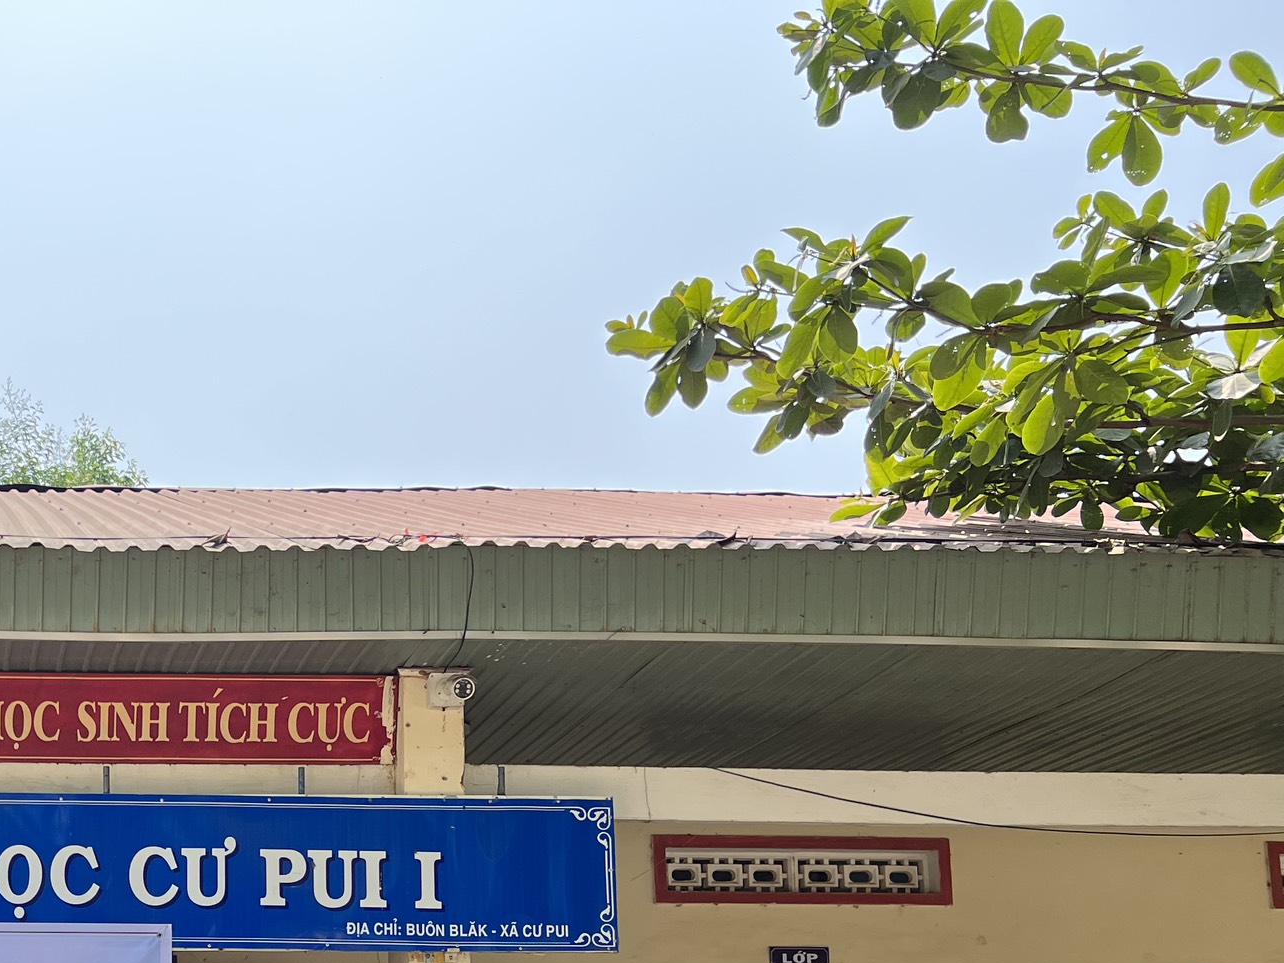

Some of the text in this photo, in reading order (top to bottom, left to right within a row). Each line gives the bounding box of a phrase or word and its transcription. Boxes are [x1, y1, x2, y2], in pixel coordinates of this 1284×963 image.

[77, 700, 171, 742] SINH
[179, 688, 279, 743] TÍCH
[287, 696, 370, 752] CỰC
[129, 837, 237, 907] CƯ
[260, 849, 388, 909] PUI
[415, 852, 443, 910] I
[347, 922, 370, 937] ĐỊA
[374, 918, 402, 936] CHỈ:
[407, 921, 445, 937] BUÔN
[450, 921, 488, 937] BLĂK
[501, 922, 519, 937] XÃ
[523, 923, 543, 937] CƯ
[547, 925, 569, 937] PUI
[782, 951, 818, 963] LỚP
